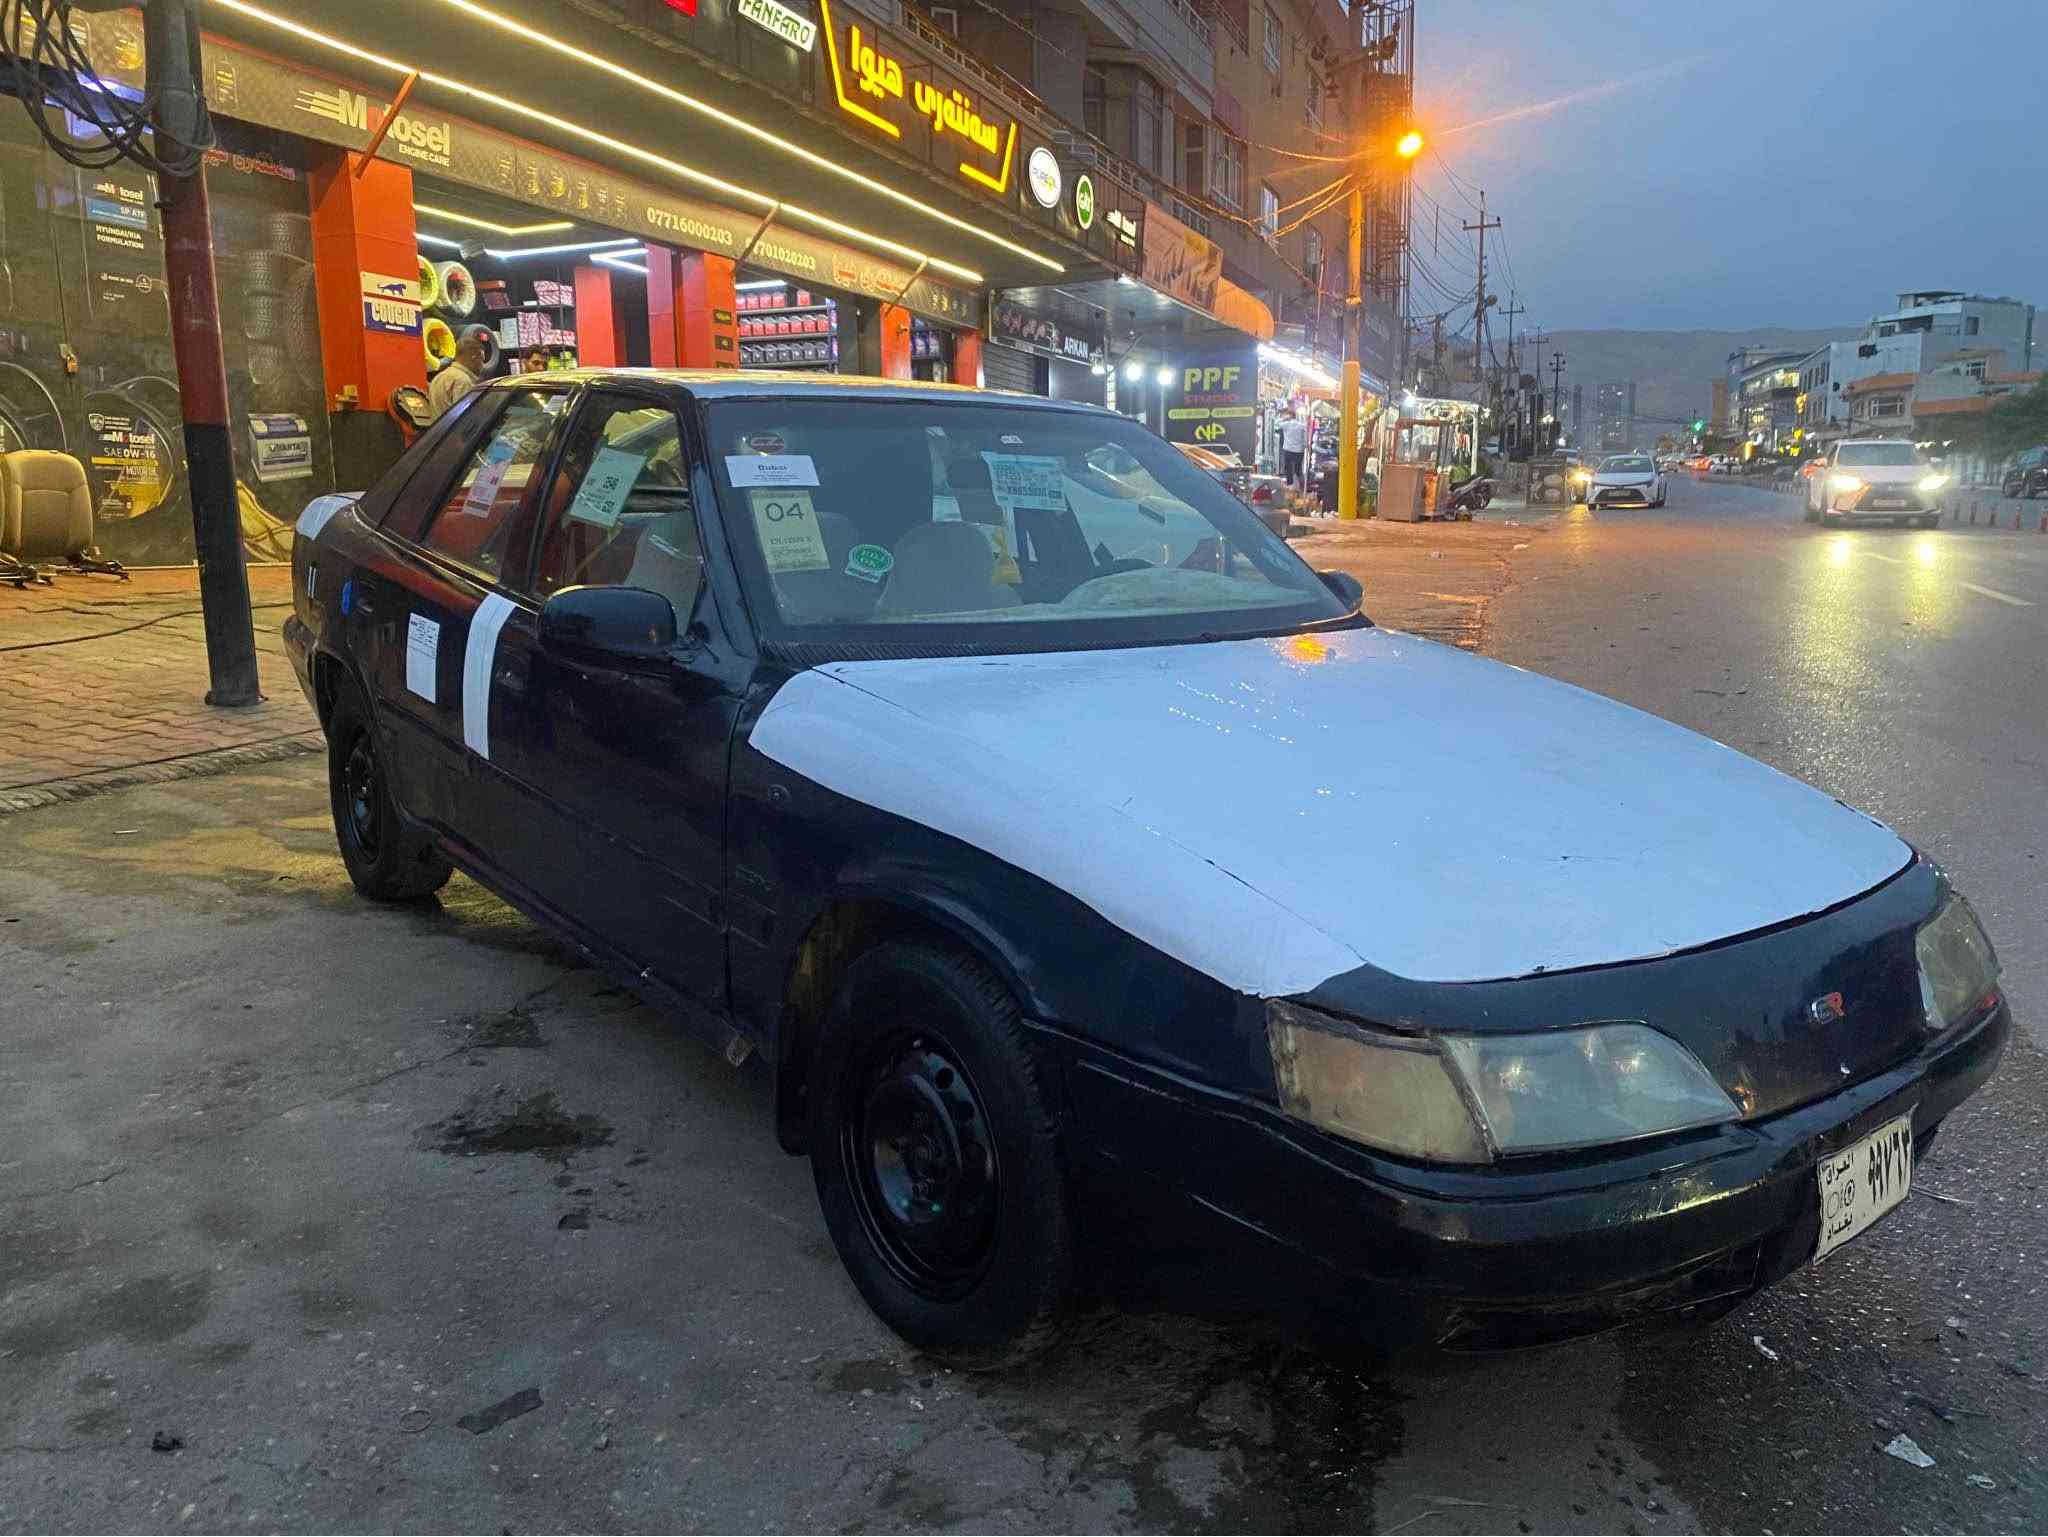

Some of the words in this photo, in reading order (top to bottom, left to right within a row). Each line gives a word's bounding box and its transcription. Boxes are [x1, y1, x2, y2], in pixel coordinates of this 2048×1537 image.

[743, 0, 811, 44] FANFARO
[428, 151, 450, 167] CARE
[646, 207, 733, 246] 07716000203
[96, 234, 144, 250] FORMULATION
[1063, 335, 1089, 360] ARKAN
[1184, 366, 1240, 392] PPF
[103, 447, 122, 458] SAE
[764, 502, 805, 522] 04
[1823, 1151, 1854, 1185] العراق
[1827, 1212, 1853, 1241] بغداد
